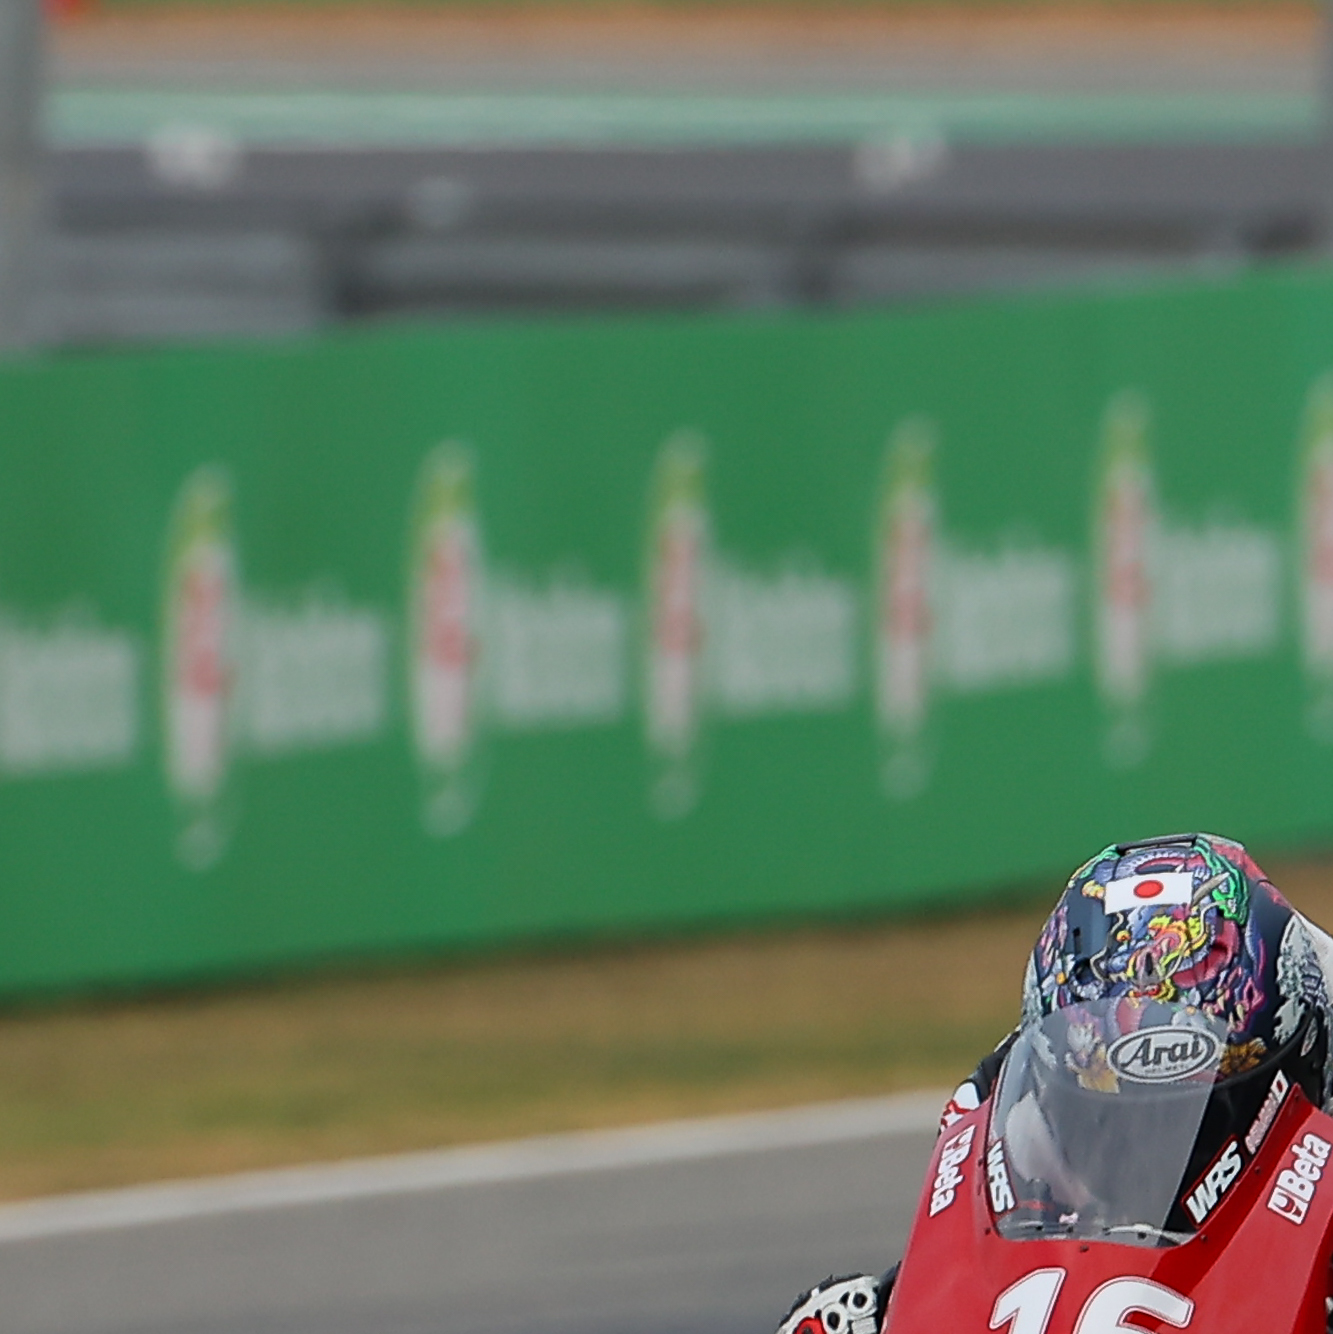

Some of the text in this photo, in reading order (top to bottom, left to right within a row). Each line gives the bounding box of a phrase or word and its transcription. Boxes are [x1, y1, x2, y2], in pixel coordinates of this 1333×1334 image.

[1121, 1033, 1206, 1068] Arai
[929, 1143, 972, 1218] Beta
[986, 1139, 1016, 1213] WRS
[1185, 1140, 1242, 1224] WRS
[1277, 1133, 1332, 1201] Beta
